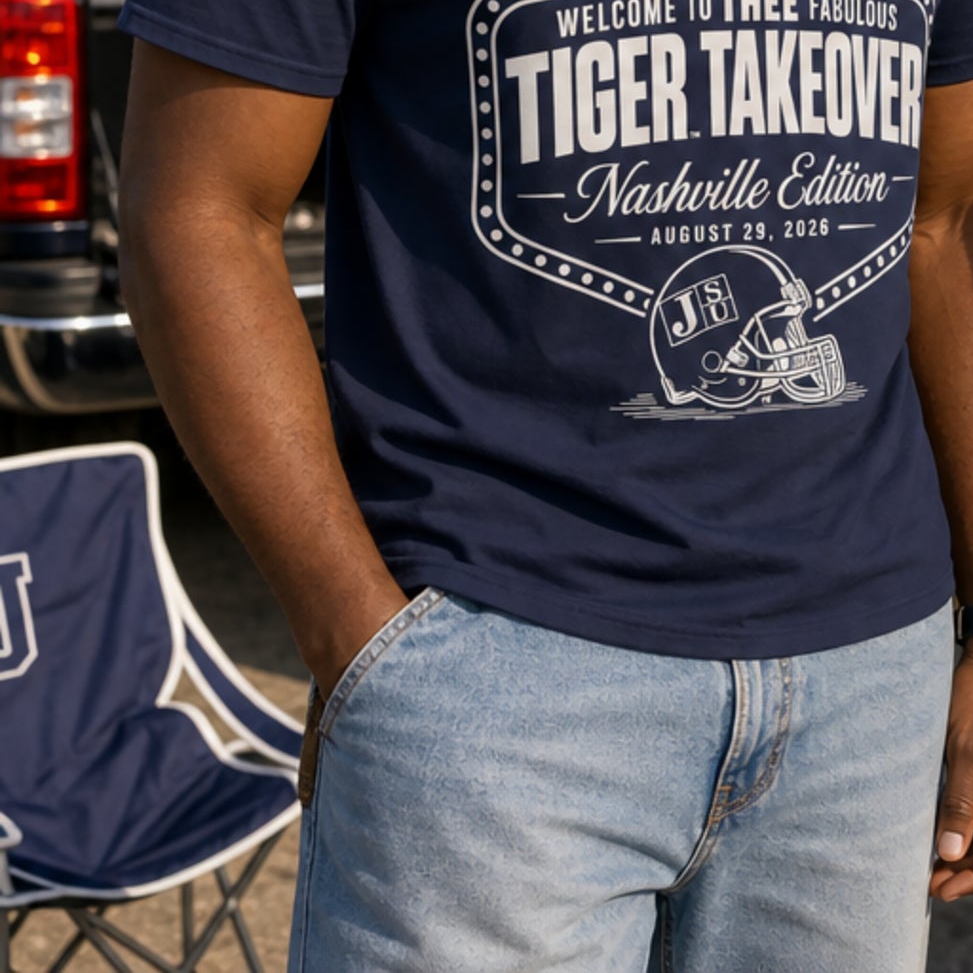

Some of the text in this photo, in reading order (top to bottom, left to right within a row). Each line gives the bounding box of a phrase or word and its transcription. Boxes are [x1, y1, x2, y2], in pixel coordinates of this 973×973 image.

[505, 29, 923, 165] TIGER TAKEOVER
[563, 151, 892, 224] Nashville Edition
[650, 218, 830, 245] AUGUST 29, 2026
